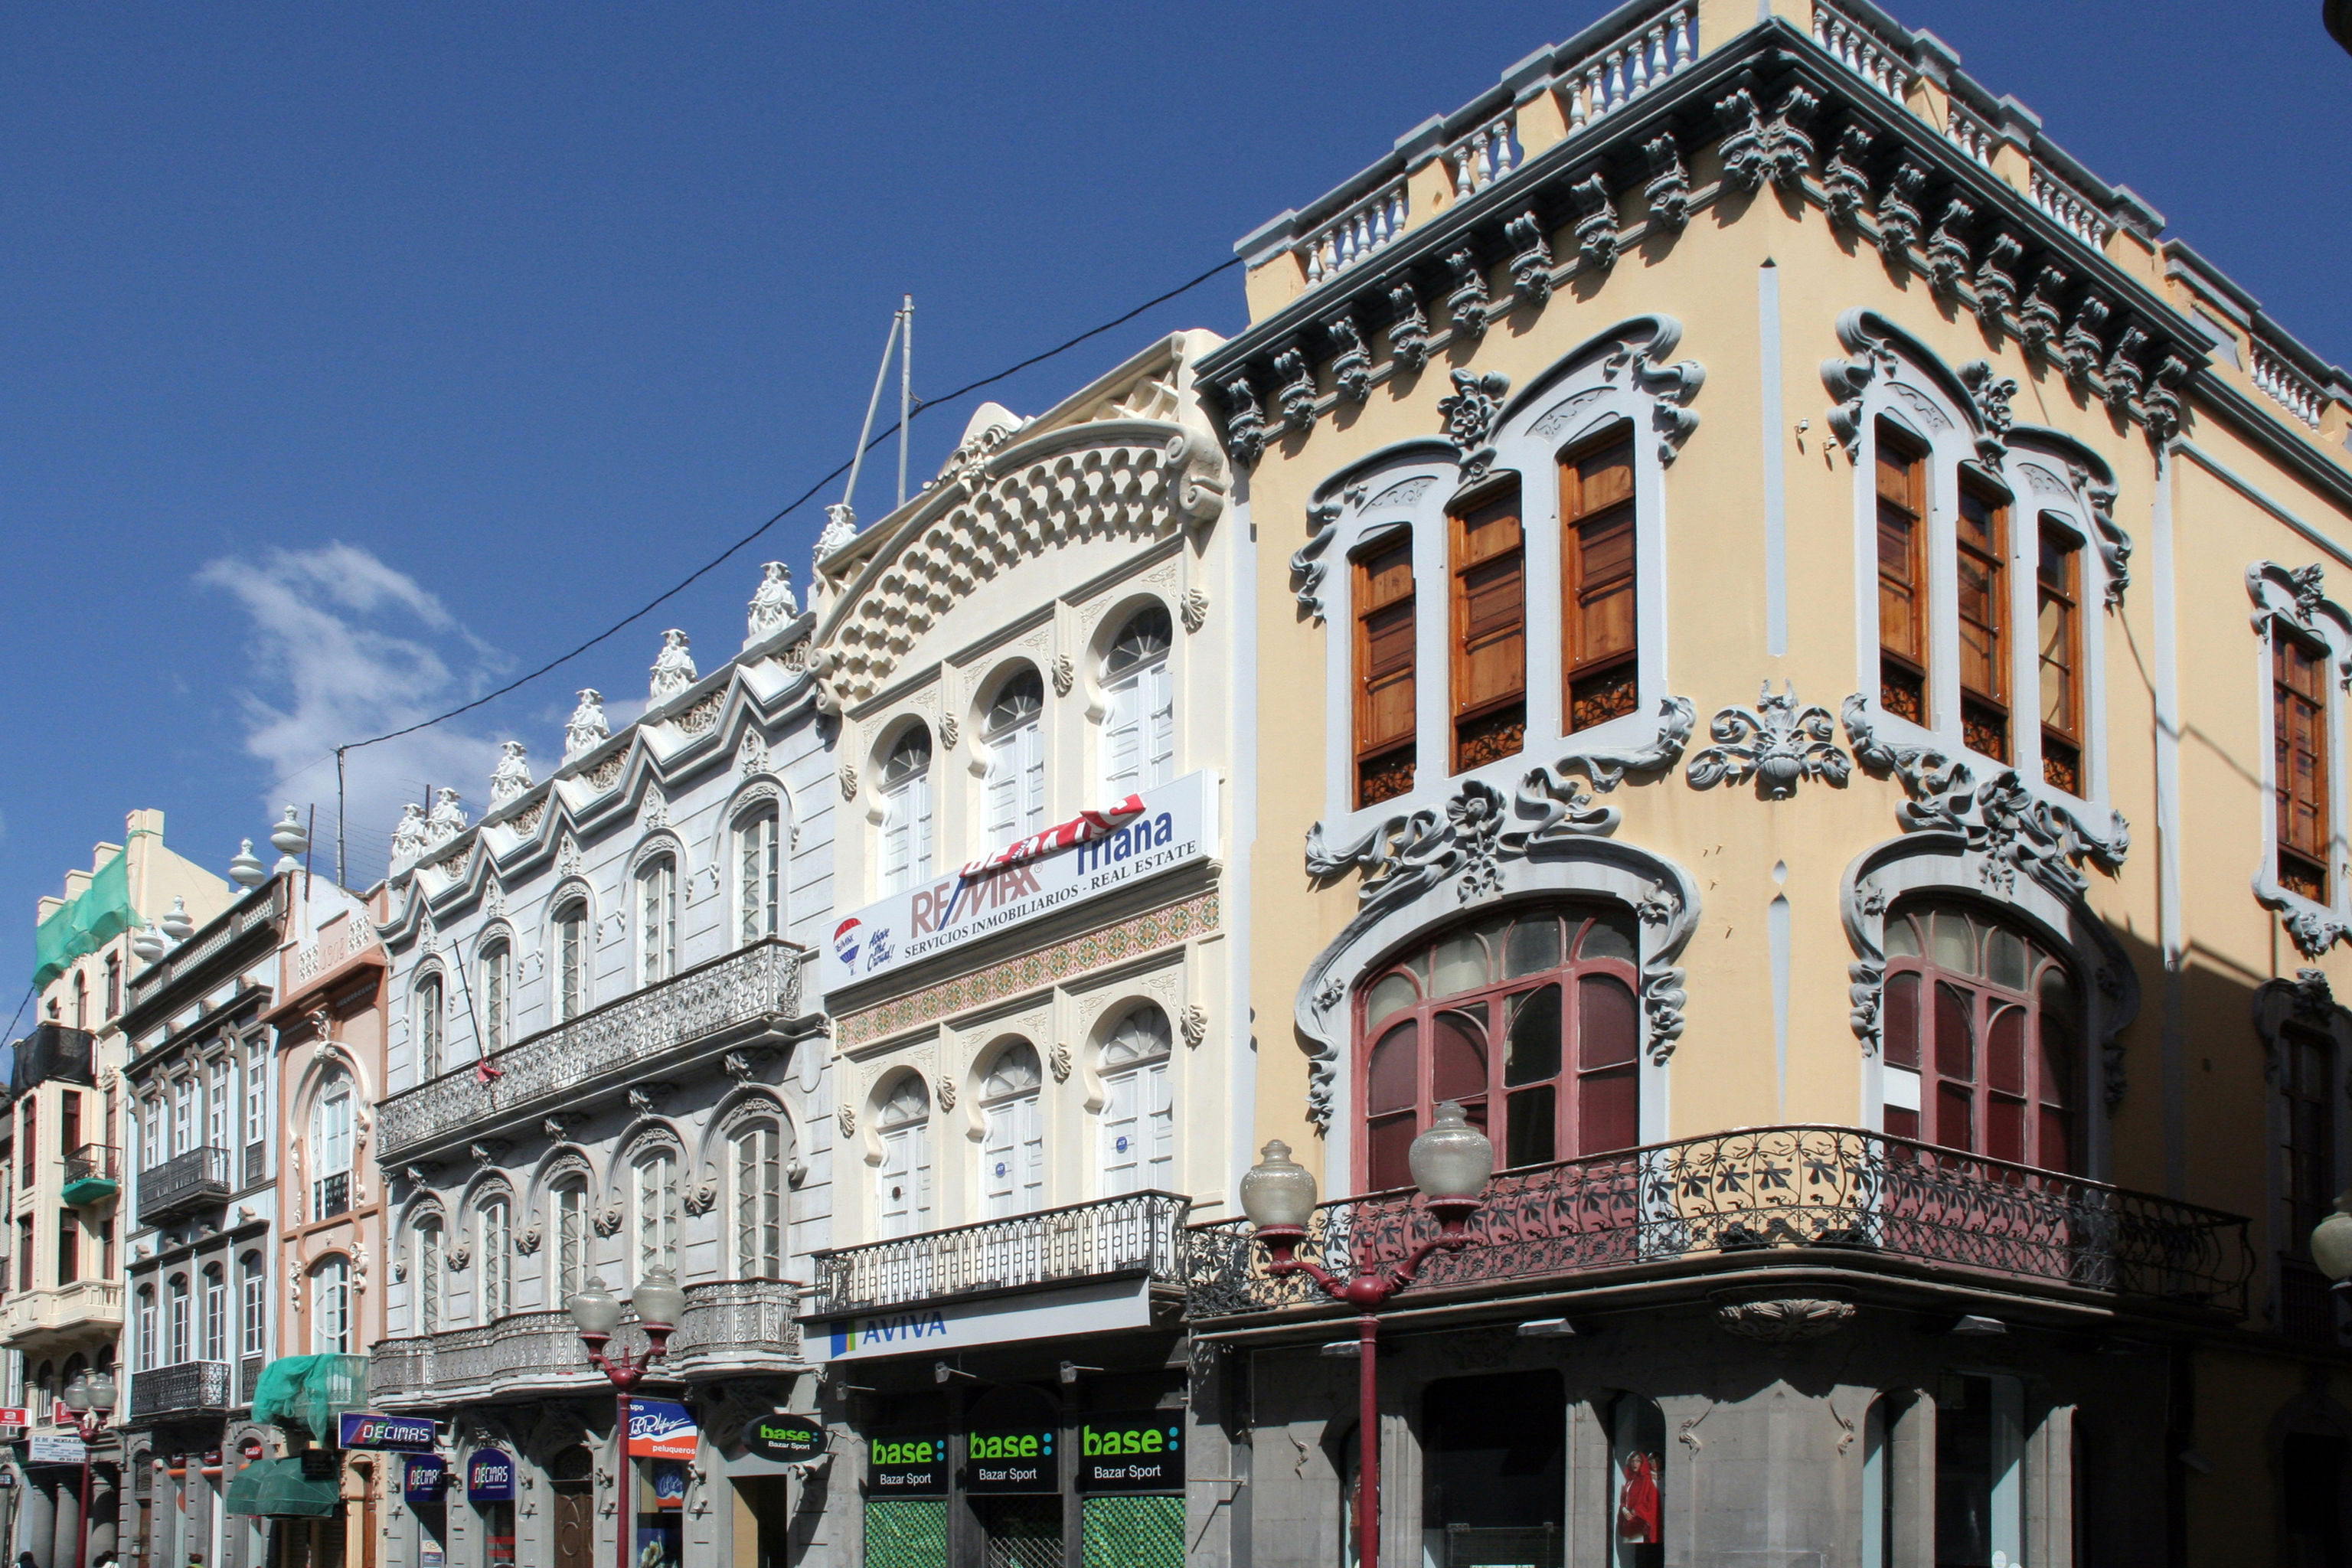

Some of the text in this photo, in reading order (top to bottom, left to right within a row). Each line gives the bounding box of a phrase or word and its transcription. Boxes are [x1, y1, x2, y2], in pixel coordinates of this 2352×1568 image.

[904, 926, 969, 959] SERVICIOS
[972, 885, 1079, 935] INMOBILIARIOS
[1091, 866, 1131, 890] REAL
[1135, 840, 1196, 874] ESTATE
[863, 1311, 947, 1344] AVIVA
[362, 1424, 430, 1441] DECIMAS
[652, 1445, 696, 1455] peluqueros
[768, 1440, 810, 1451] Bazar Sport
[475, 1465, 508, 1483] DECIMAS
[880, 1472, 932, 1486] Bazar Sport
[979, 1468, 1037, 1482] Bazar Sport
[1094, 1465, 1161, 1481] Bazar Sport
